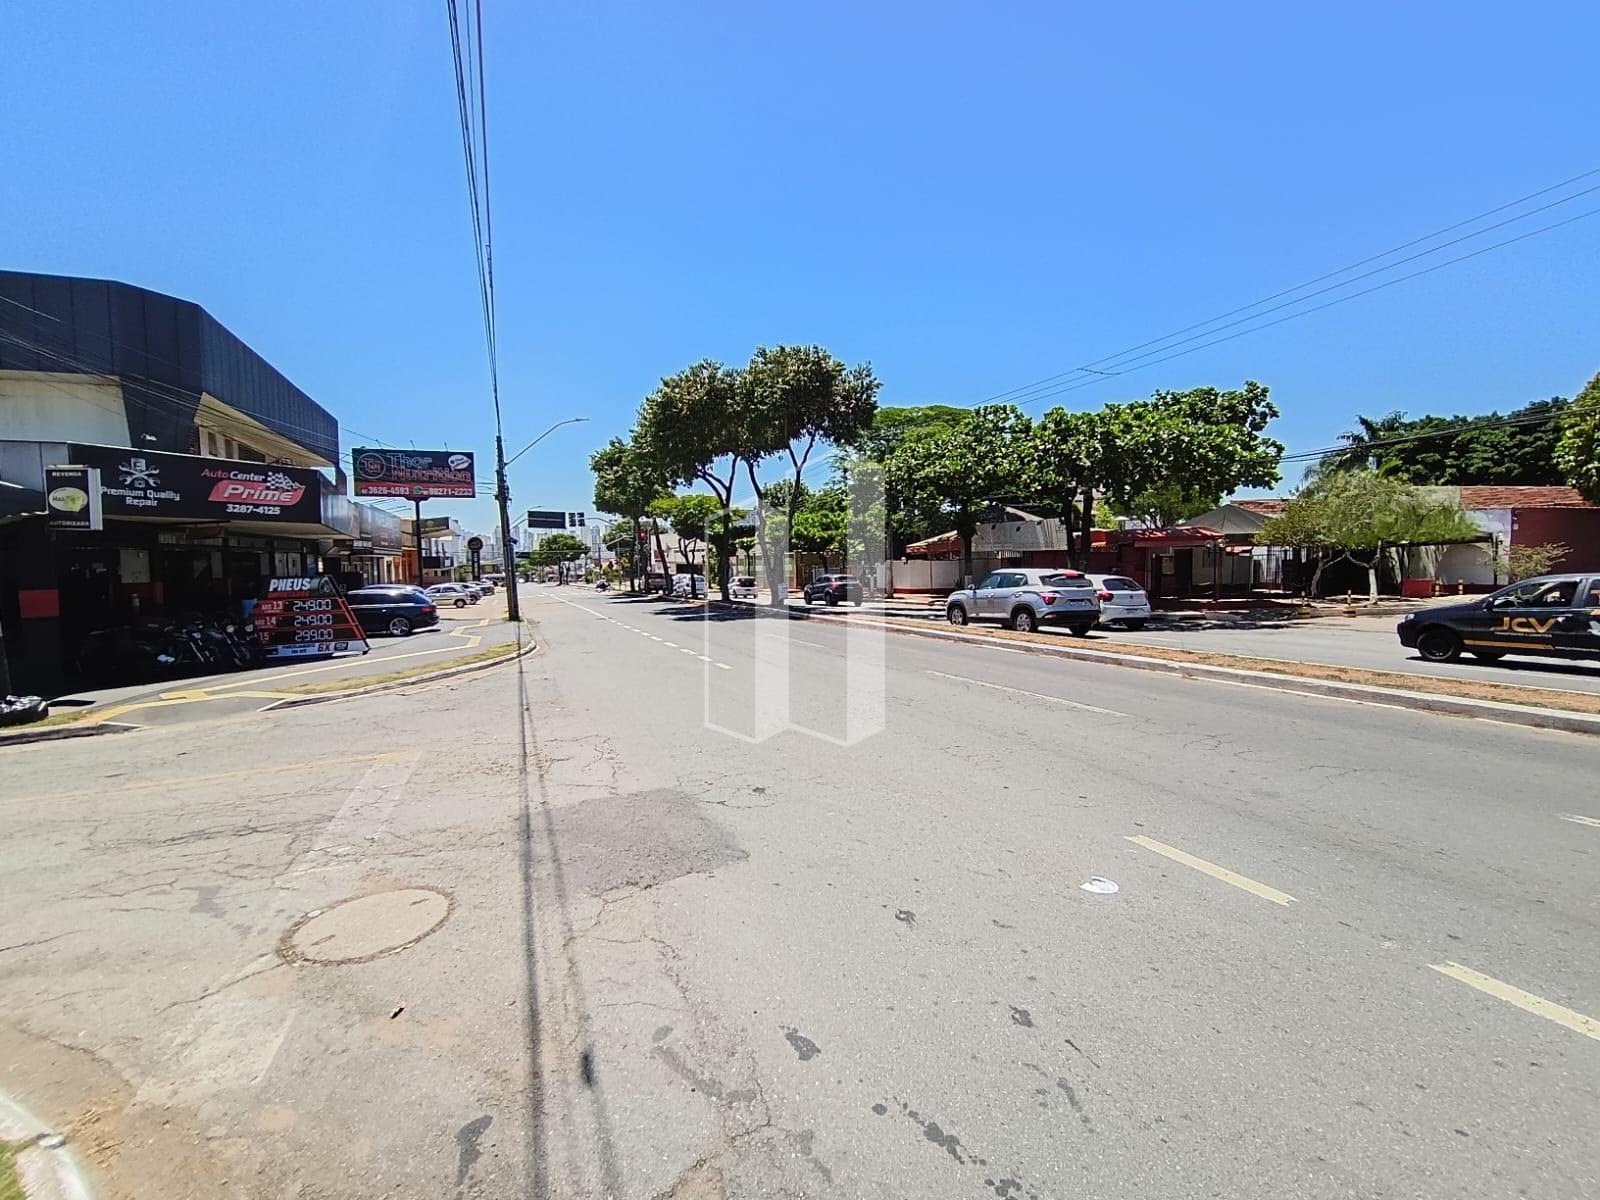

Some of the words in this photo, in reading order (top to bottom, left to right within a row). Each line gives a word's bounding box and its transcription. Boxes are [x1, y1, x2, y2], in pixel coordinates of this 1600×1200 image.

[386, 453, 432, 468] Thor
[201, 468, 228, 479] Auto
[230, 471, 265, 482] Center
[100, 486, 144, 498] Premium
[147, 489, 180, 501] Quality
[223, 484, 293, 502] Prime
[125, 496, 158, 507] Repair
[226, 504, 281, 515] 3287-4125
[269, 578, 311, 591] PNEUS
[272, 601, 283, 610] 13
[265, 616, 276, 625] 14
[1488, 617, 1557, 633] JCV
